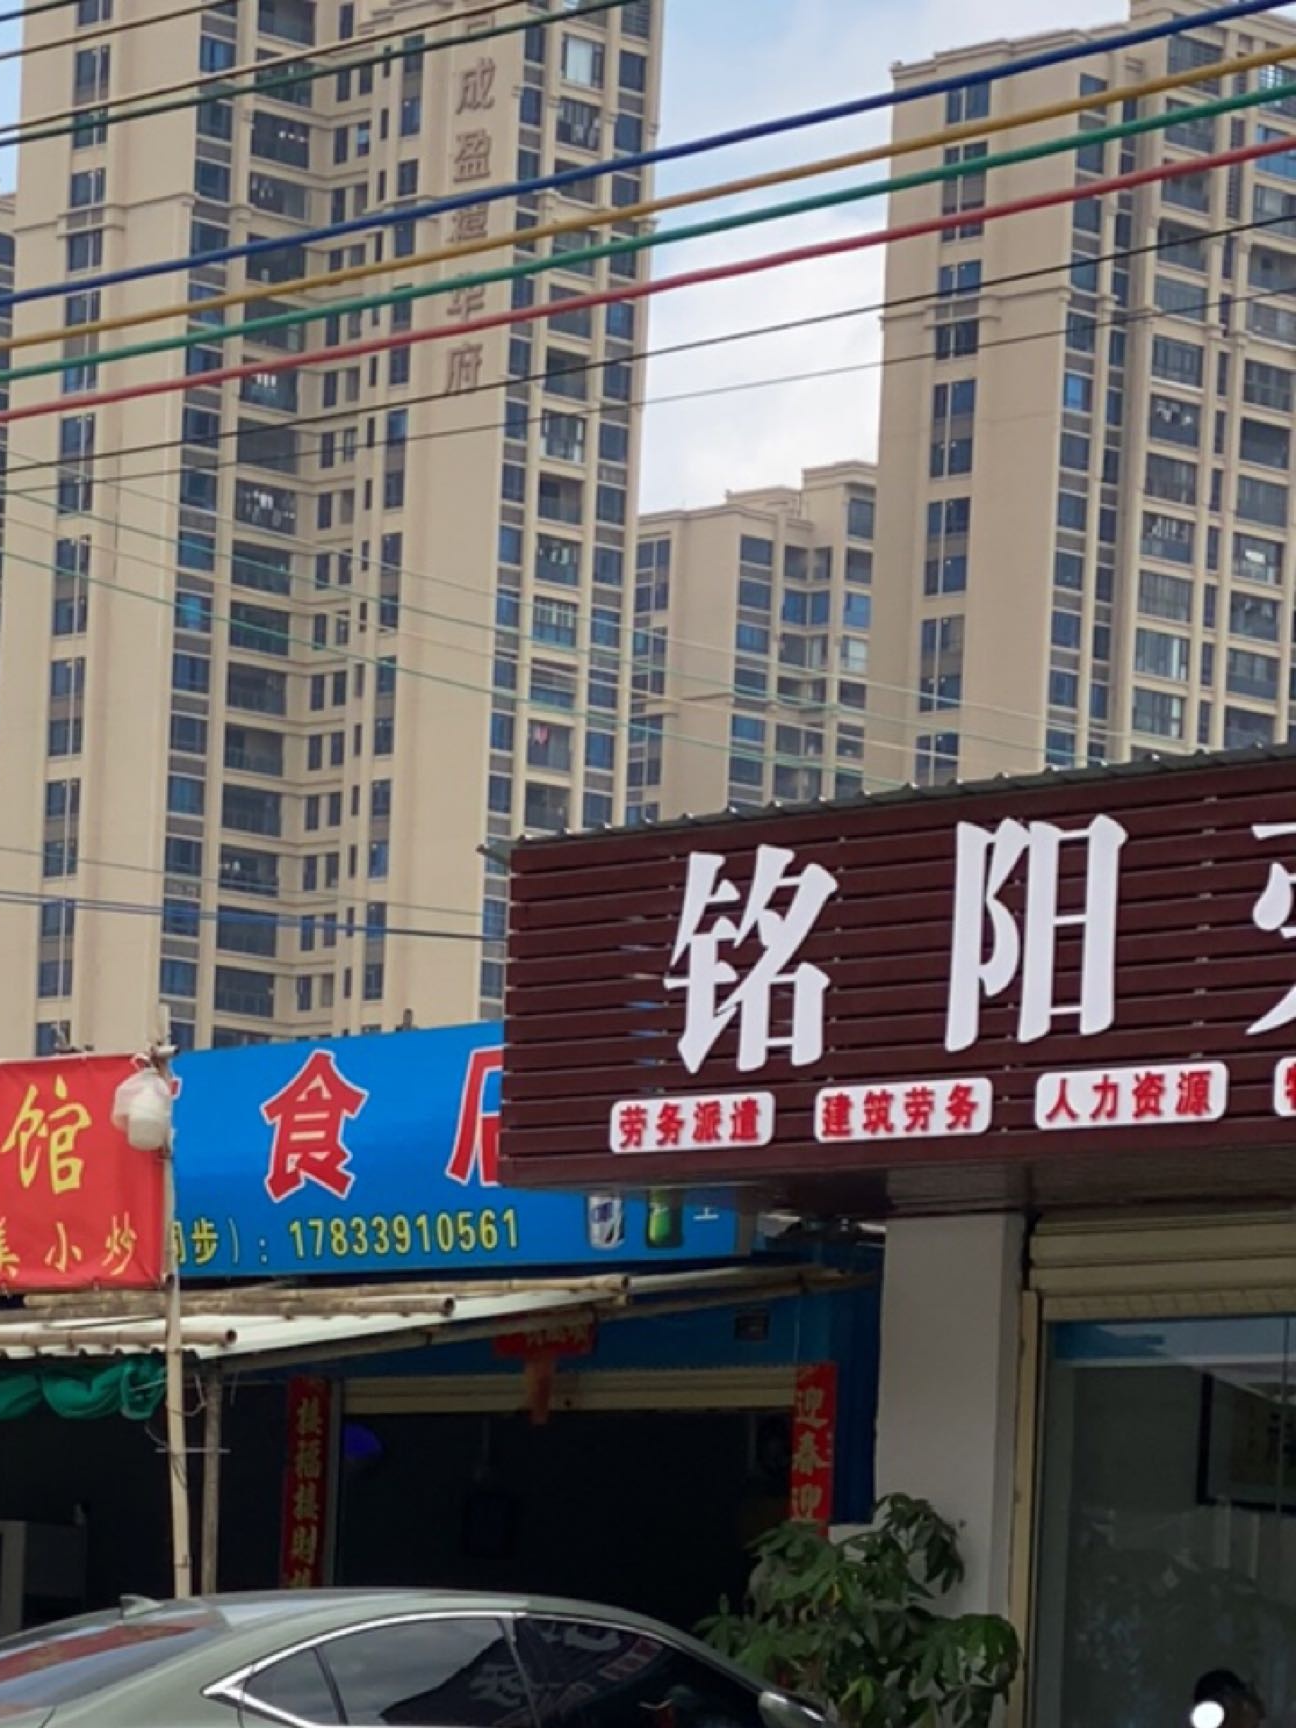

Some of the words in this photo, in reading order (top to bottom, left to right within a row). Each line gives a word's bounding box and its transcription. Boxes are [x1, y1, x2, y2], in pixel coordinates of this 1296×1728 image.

[822, 1084, 980, 1138] 建筑劳务
[1045, 1070, 1212, 1122] 人力资源
[618, 1101, 761, 1148] 劳务派遣
